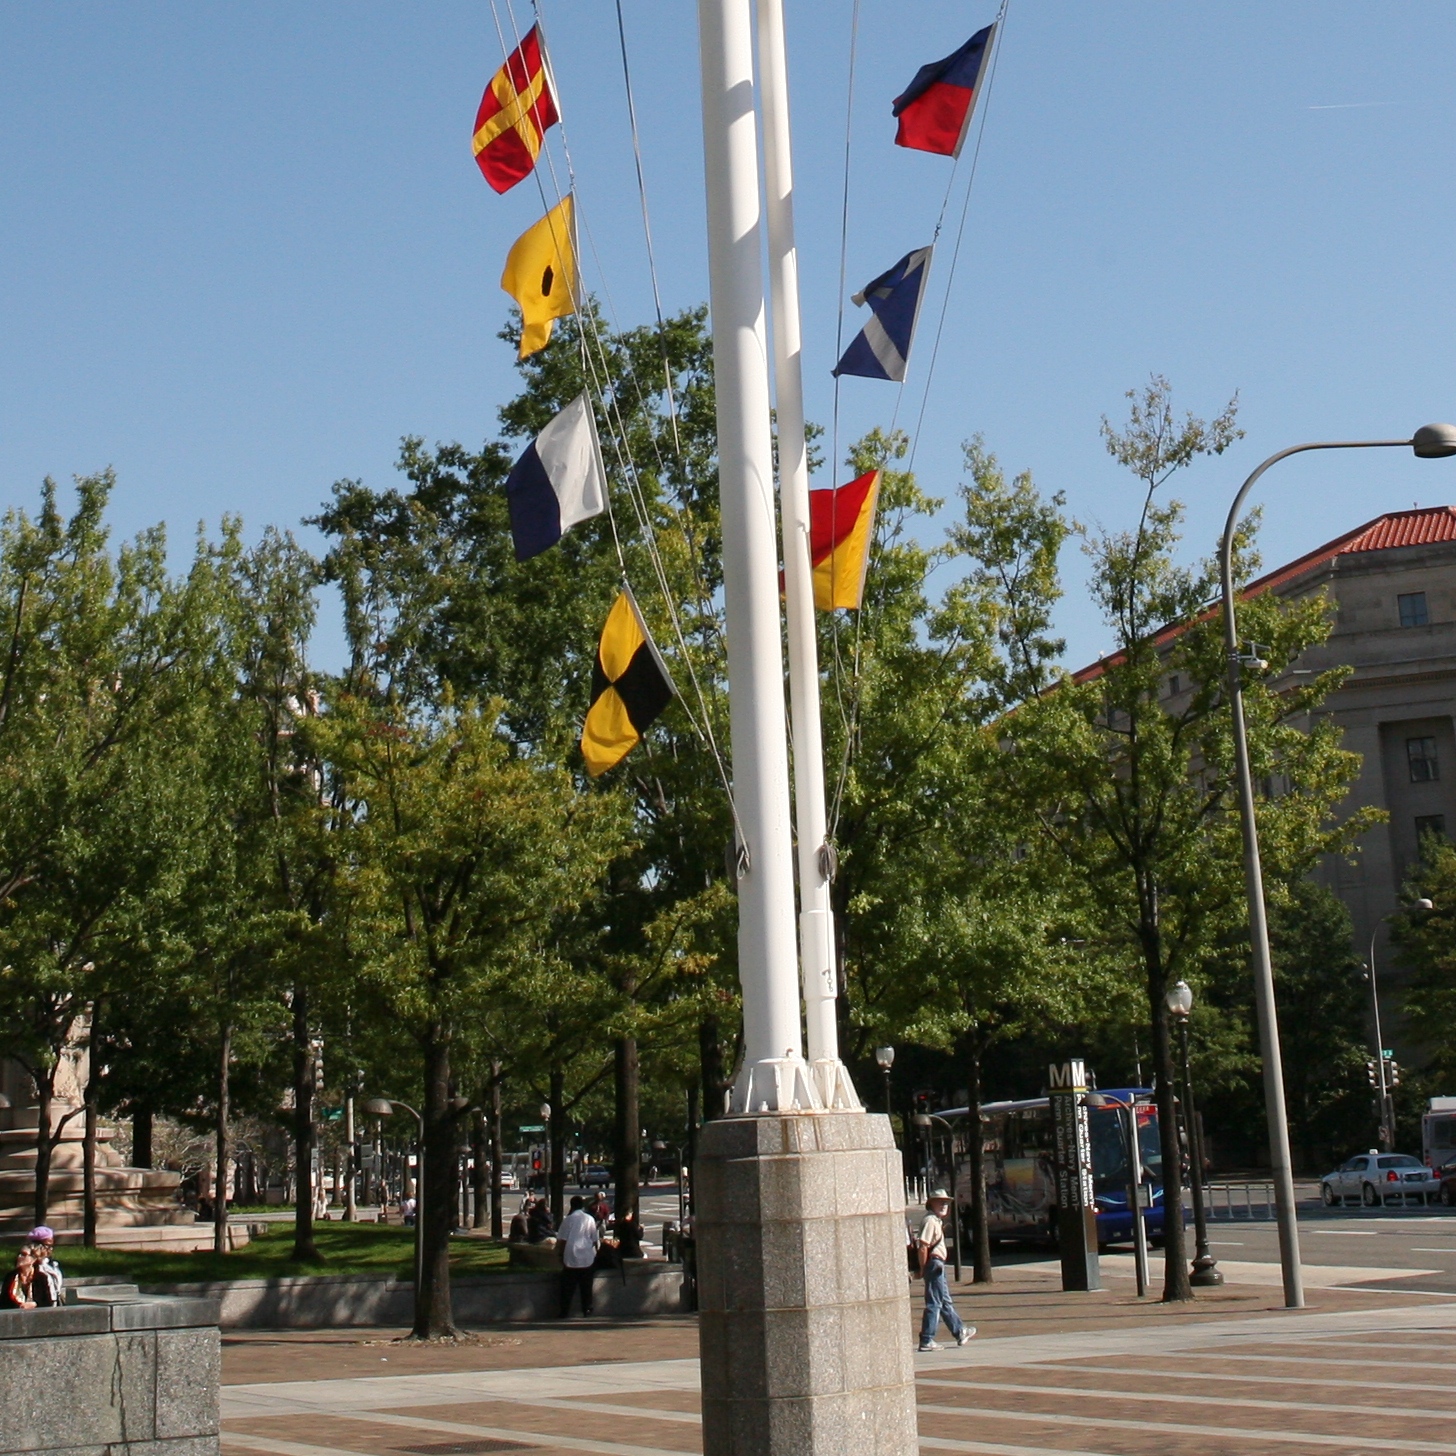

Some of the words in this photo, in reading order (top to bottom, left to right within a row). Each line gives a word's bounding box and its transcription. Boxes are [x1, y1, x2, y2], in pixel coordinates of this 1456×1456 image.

[1049, 1062, 1071, 1087] M
[1072, 1061, 1086, 1086] M
[1054, 1095, 1062, 1121] Penn
[1056, 1126, 1066, 1164] Quarter
[1064, 1095, 1076, 1170] Archives-Navy
[1059, 1170, 1068, 1208] Station
